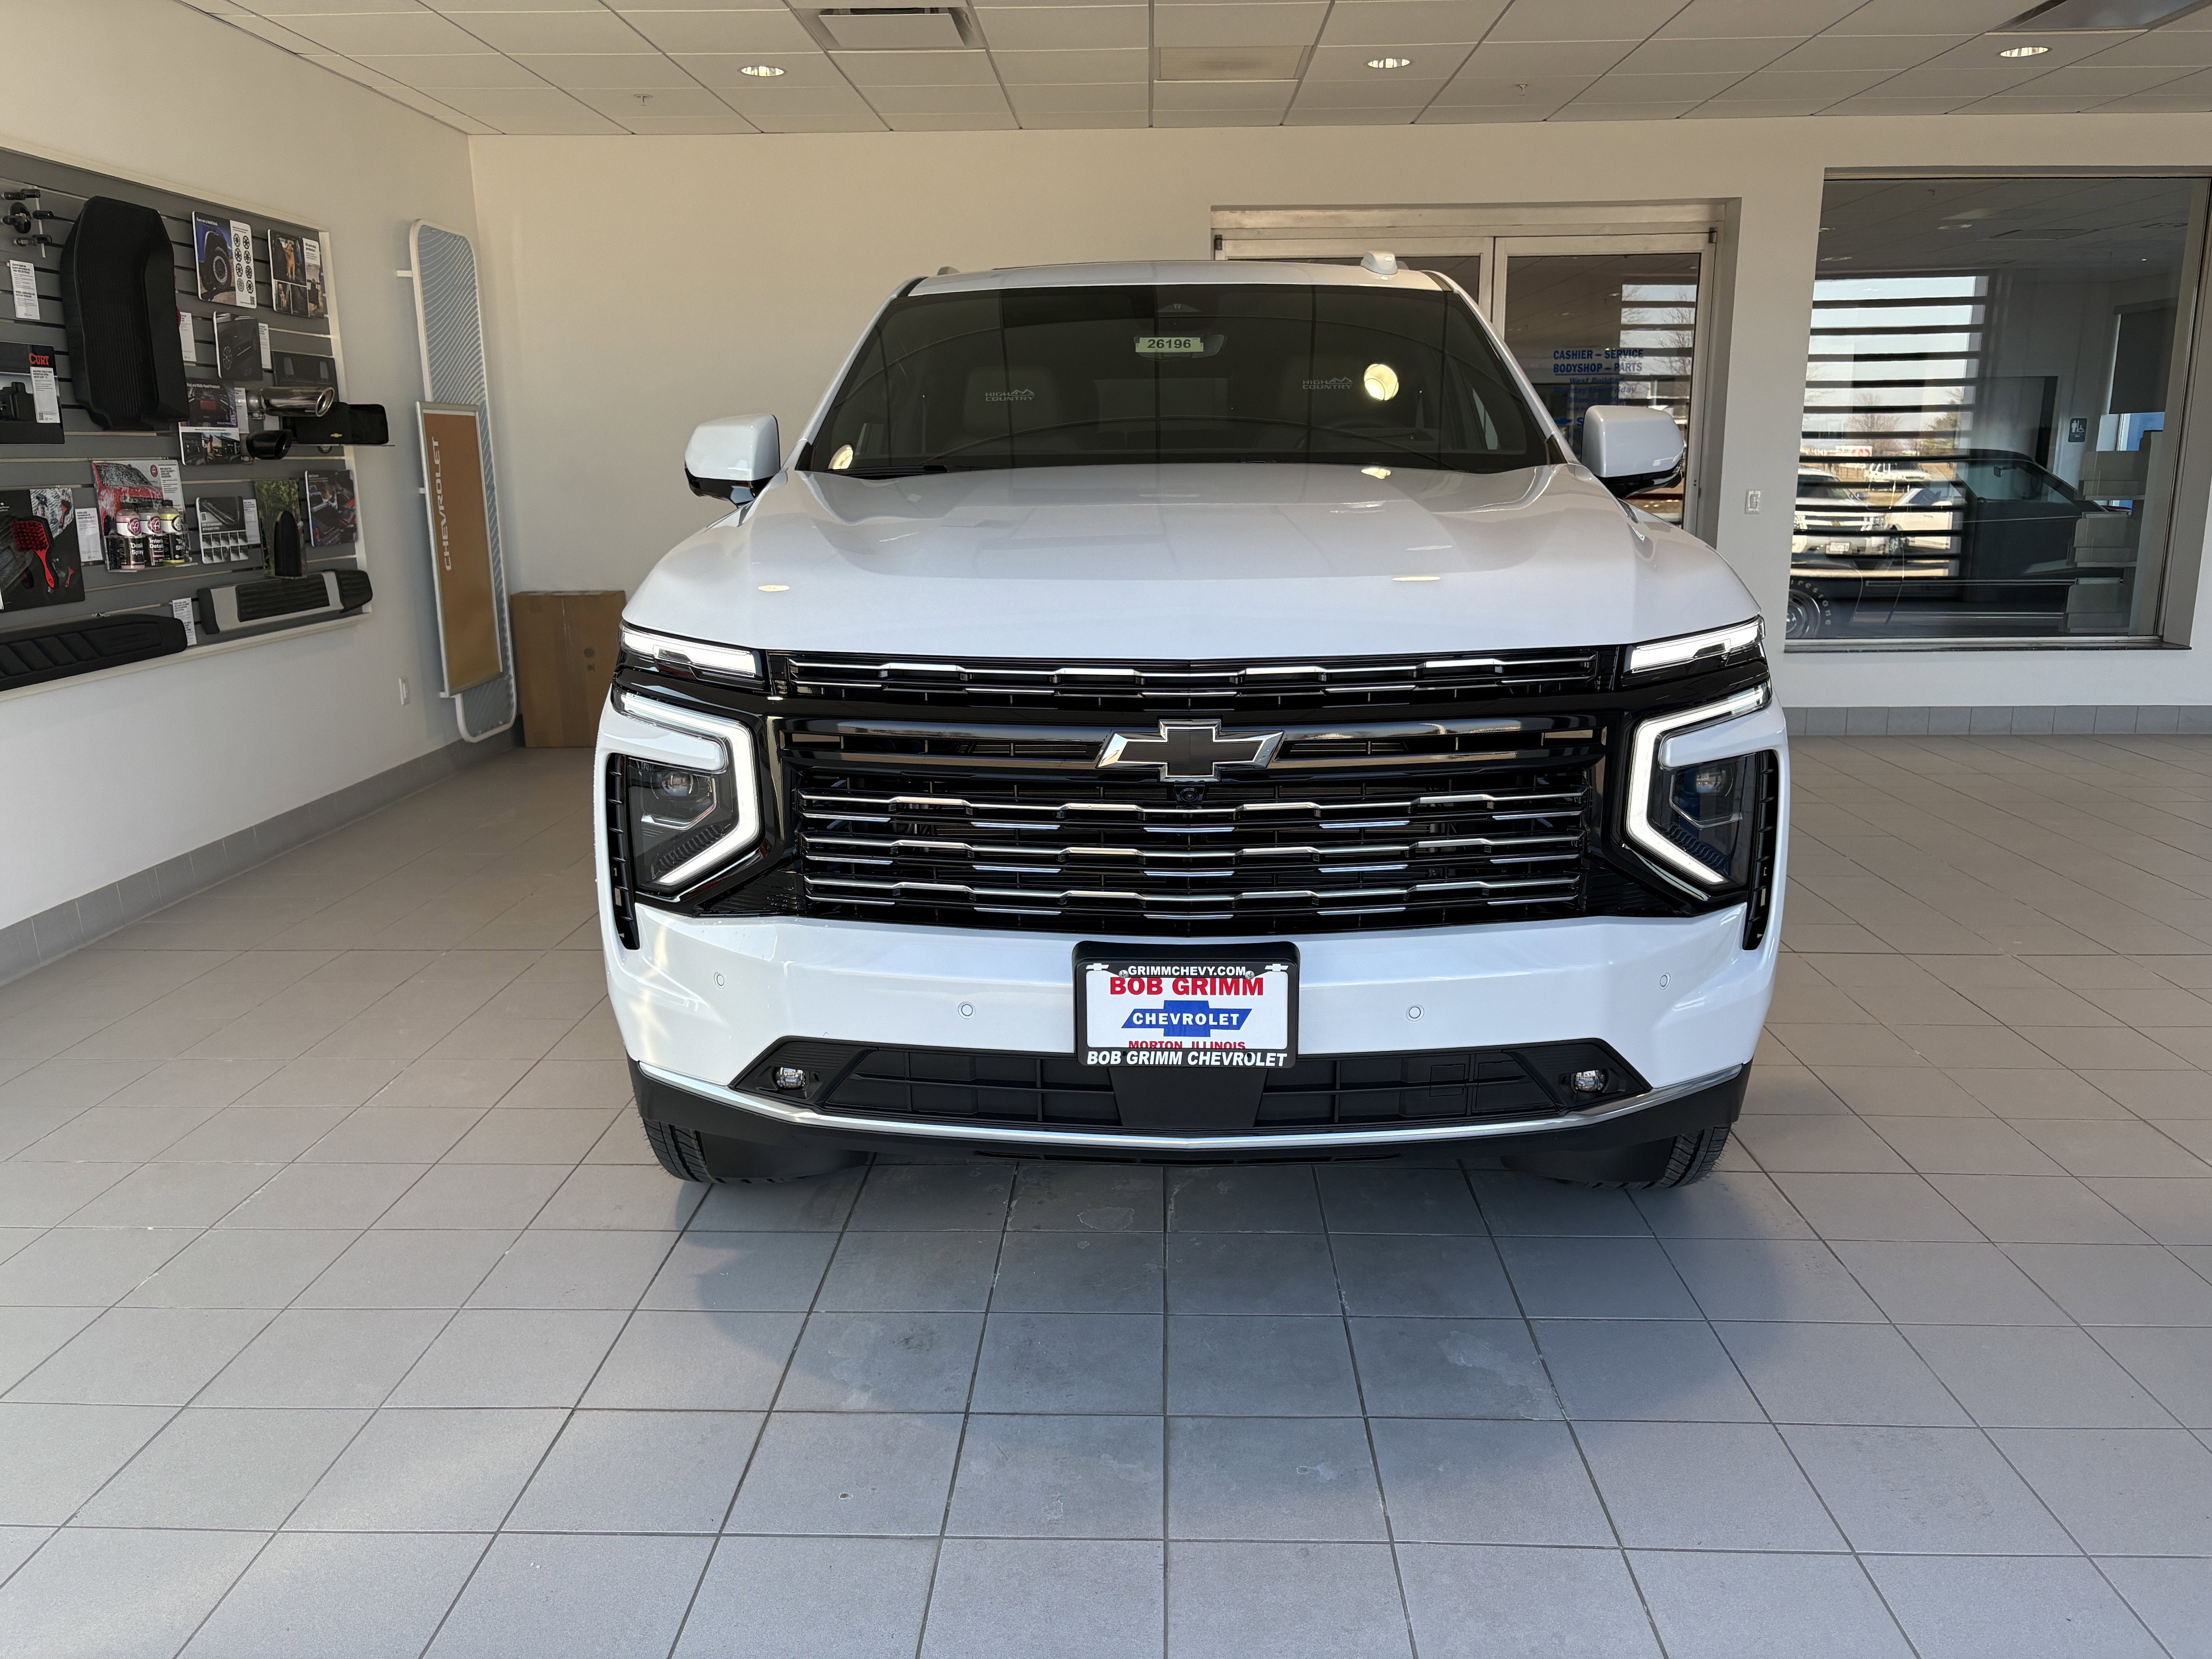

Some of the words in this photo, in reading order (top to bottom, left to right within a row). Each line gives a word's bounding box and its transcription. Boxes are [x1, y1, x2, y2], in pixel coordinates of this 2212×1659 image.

[1147, 339, 1191, 348] 26196
[29, 353, 50, 365] CURT
[1553, 350, 1593, 359] CASHIER
[1604, 349, 1644, 359] SERVICE
[1553, 363, 1602, 373] BODYSHOP
[1614, 362, 1643, 372] PARTS
[432, 436, 452, 570] CHEVROLET
[1790, 579, 1832, 625] irestone
[1128, 965, 1246, 976] GRIMMCHEVY.COM
[1110, 977, 1163, 995] BOB
[1172, 977, 1264, 996] GRIMM
[1132, 1012, 1239, 1025] CHEVROLET
[1087, 1051, 1121, 1065] BOB
[1126, 1051, 1183, 1066] GRIMM
[1188, 1051, 1288, 1067] CHEVROLET
